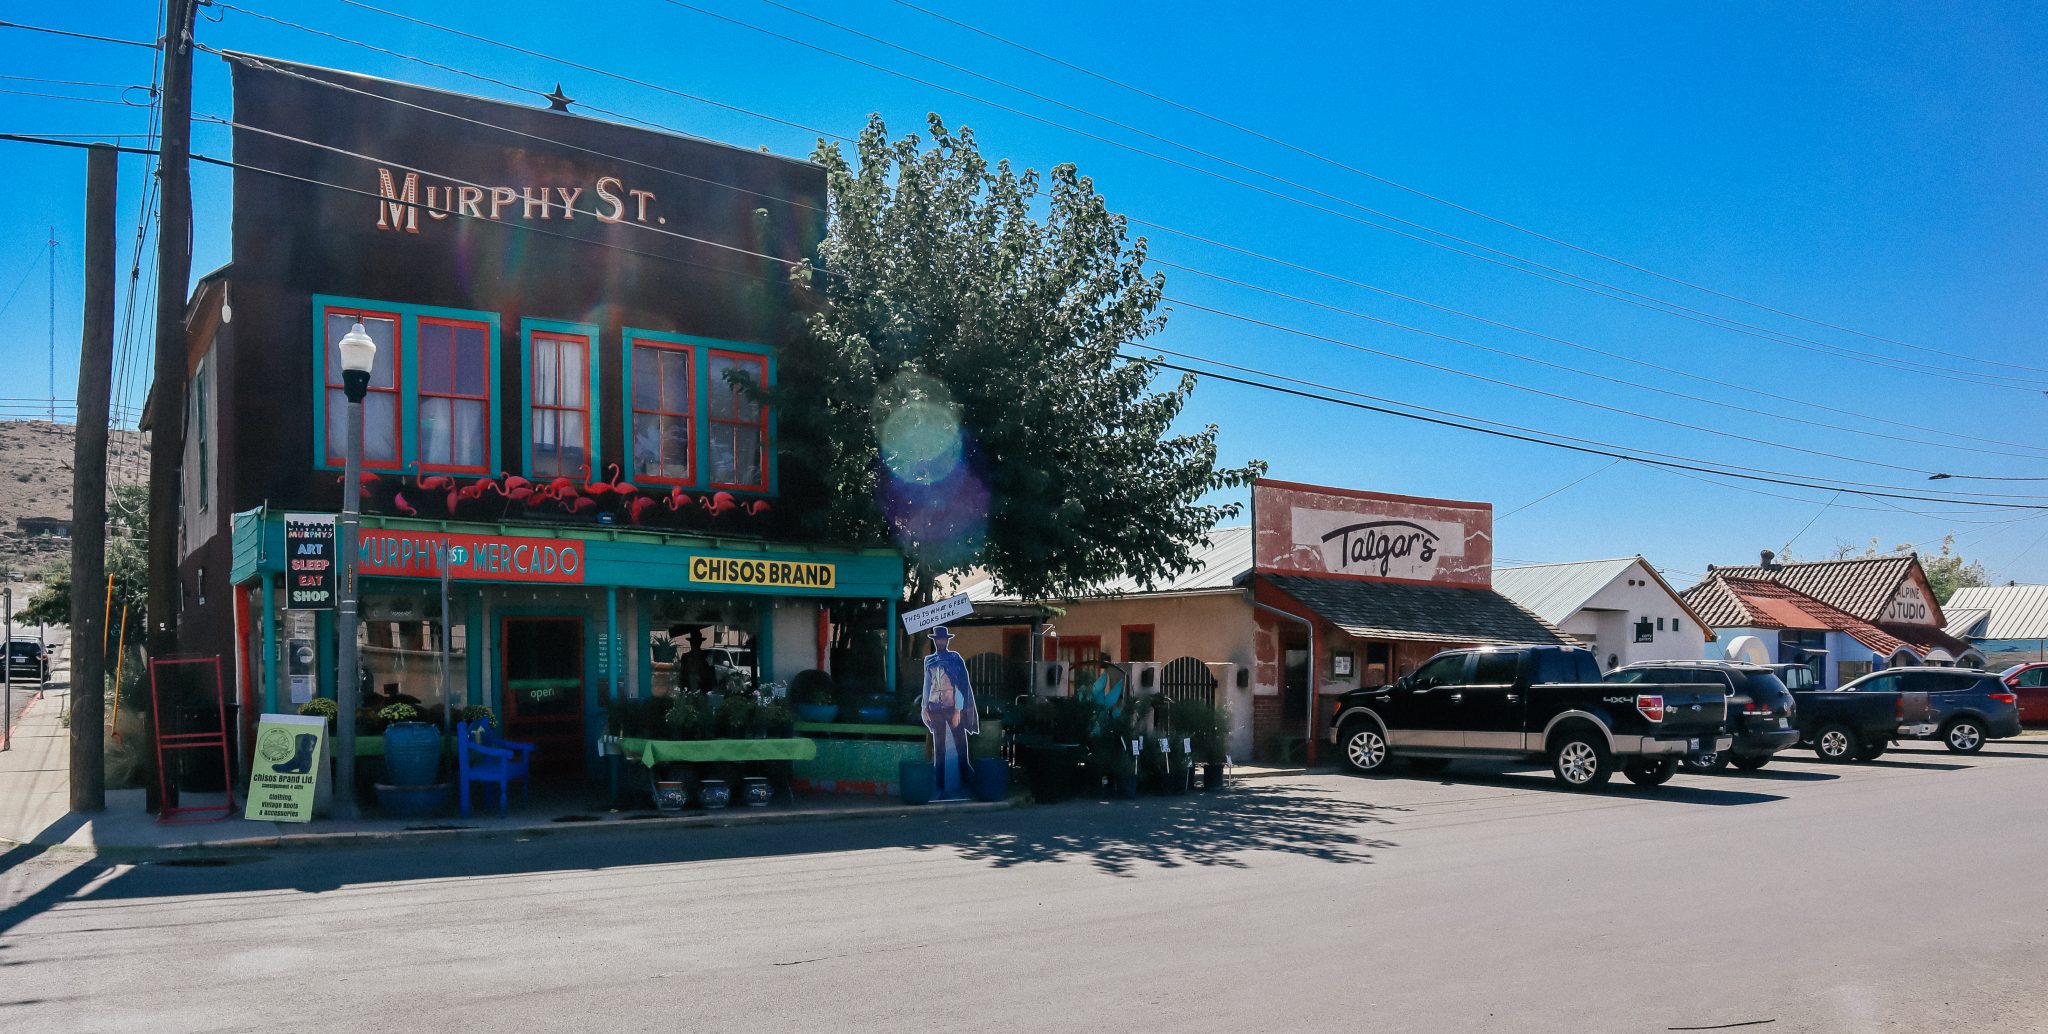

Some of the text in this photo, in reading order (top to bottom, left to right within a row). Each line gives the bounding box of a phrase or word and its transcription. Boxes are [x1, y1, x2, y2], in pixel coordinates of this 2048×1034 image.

[376, 168, 583, 234] MURPHY
[297, 543, 324, 555] ART
[1321, 520, 1440, 577] Talgar's
[291, 559, 330, 571] SLEEP
[473, 542, 579, 575] MERCADO
[298, 575, 324, 586] EAT
[693, 558, 832, 586] CHISOS BRAND
[292, 590, 330, 602] SHOP
[1895, 586, 1920, 600] ALPINE
[904, 614, 921, 624] THIS
[922, 610, 930, 618] IS
[930, 604, 947, 615] WHAT
[953, 597, 968, 607] FEET
[1888, 597, 1926, 620] STUDIO
[919, 615, 940, 627] LOOKS
